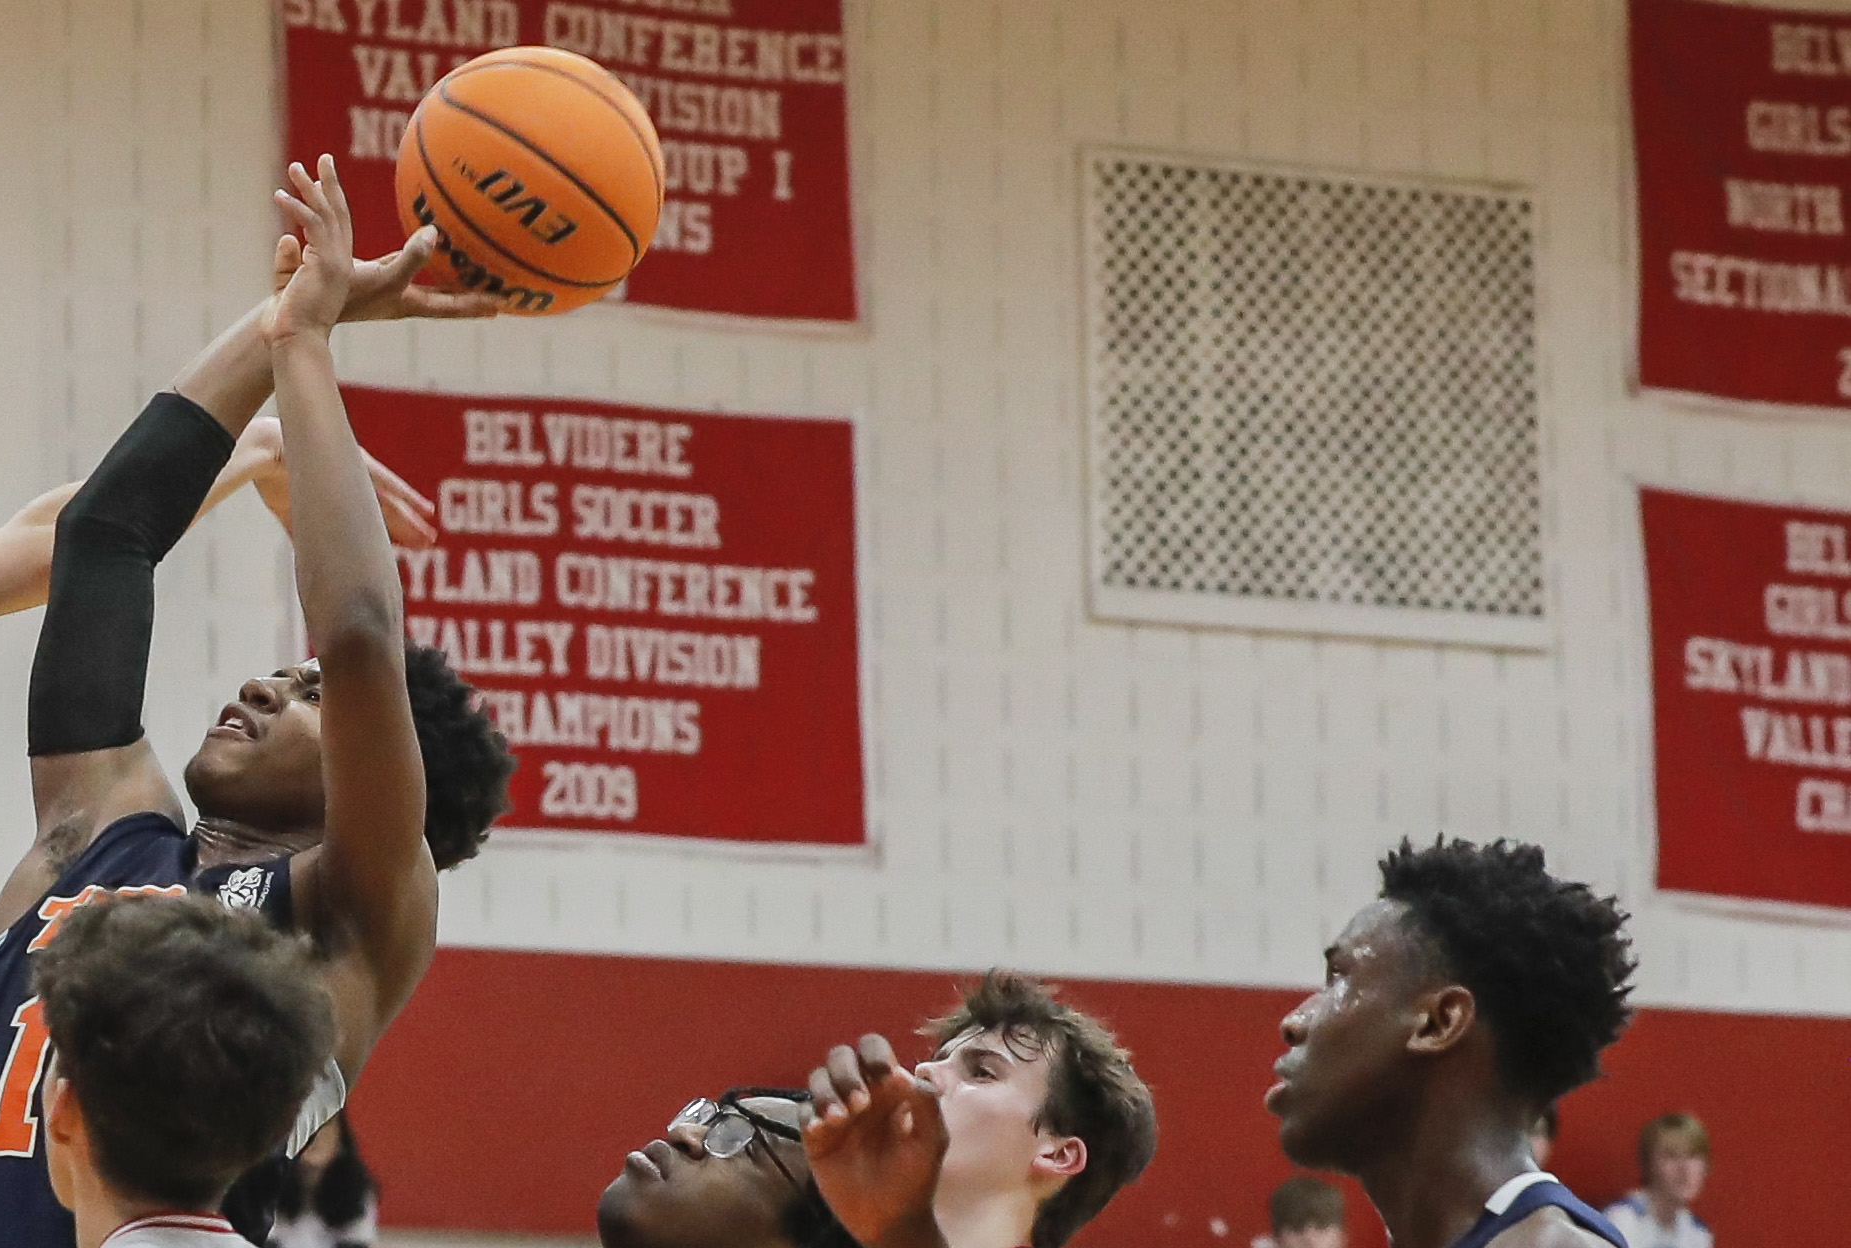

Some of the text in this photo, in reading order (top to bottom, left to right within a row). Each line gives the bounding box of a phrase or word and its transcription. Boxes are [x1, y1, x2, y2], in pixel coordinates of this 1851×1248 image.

[545, 4, 842, 83] CONFERENCE
[464, 408, 693, 478] BELVIDERE
[437, 478, 721, 548] GIRLS SOCCER
[555, 552, 818, 622] CONFERENCE
[585, 623, 761, 689] DIVISION
[541, 762, 638, 822] 2009
